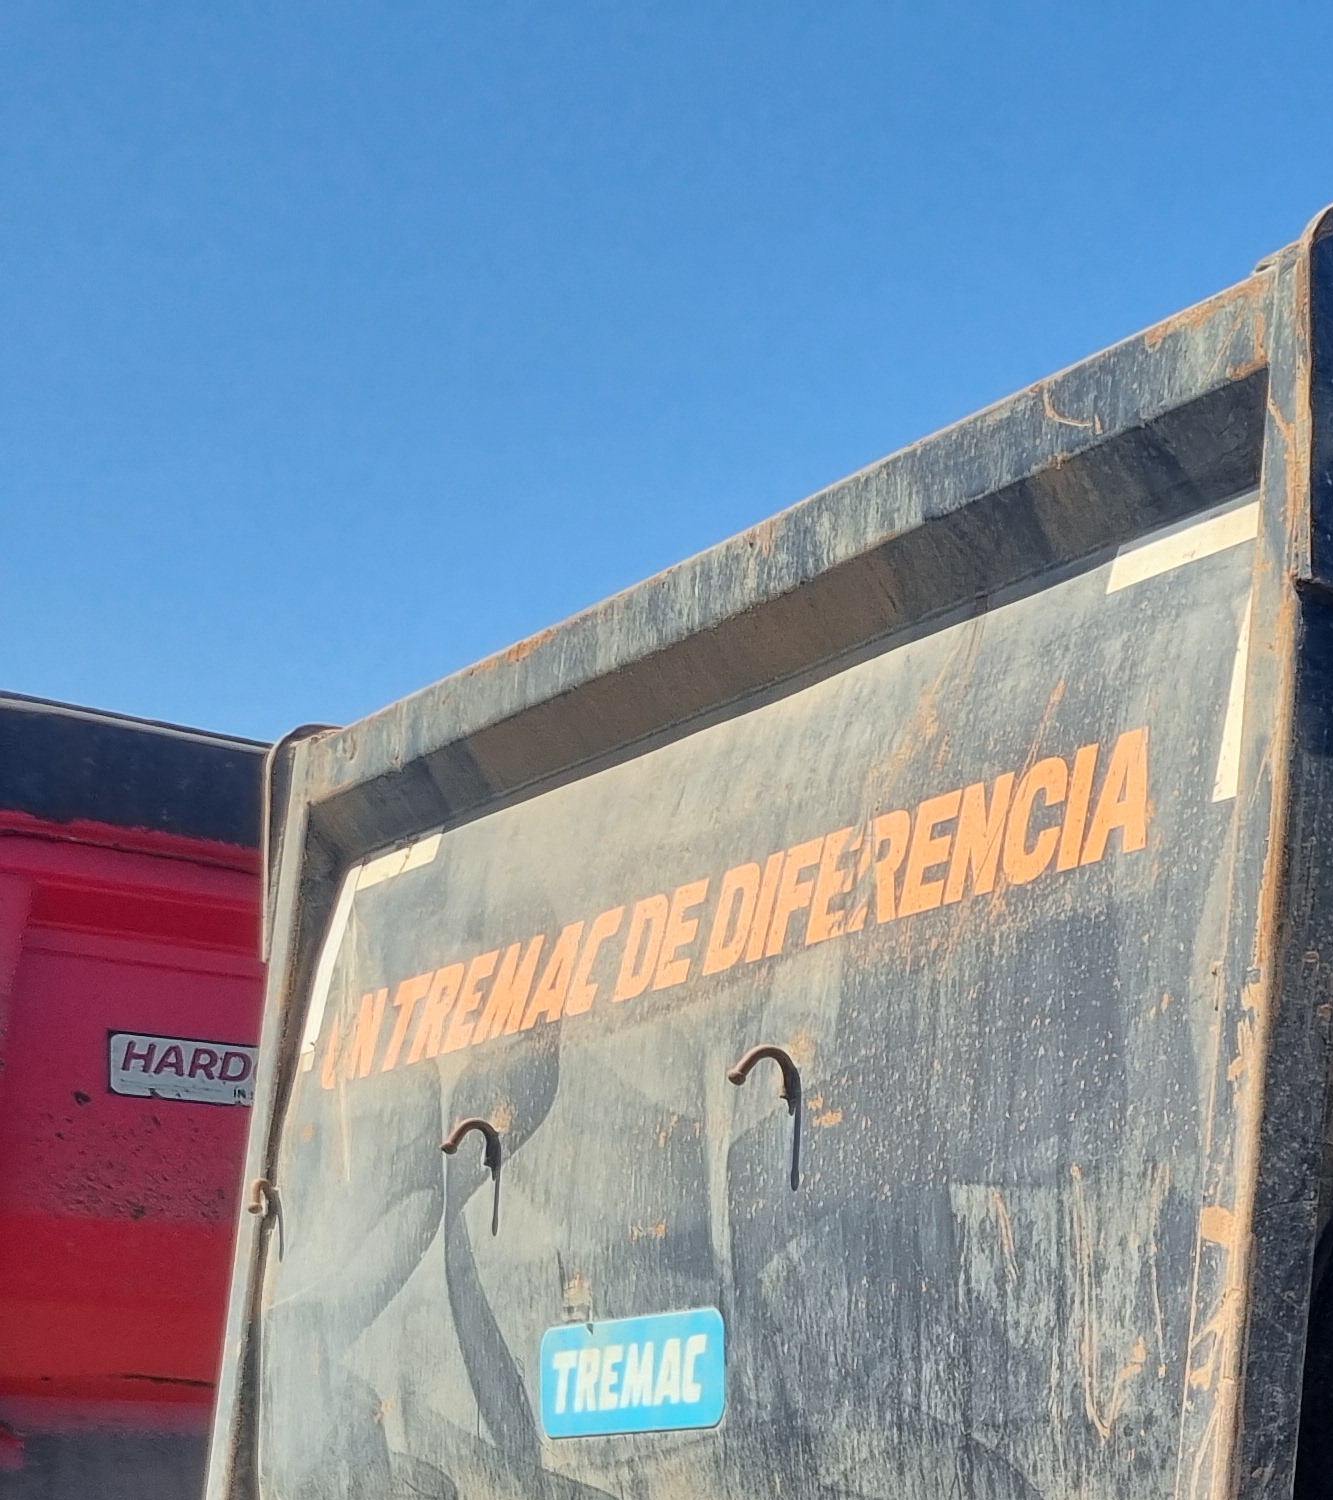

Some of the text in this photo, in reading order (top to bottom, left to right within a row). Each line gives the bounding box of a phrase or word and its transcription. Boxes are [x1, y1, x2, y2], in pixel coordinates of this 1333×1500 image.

[381, 905, 625, 1073] TREMAC
[612, 878, 710, 1003] DE
[702, 725, 1150, 977] DIFERENCIA
[121, 1040, 257, 1082] HARD
[553, 1334, 707, 1414] TREMAC
